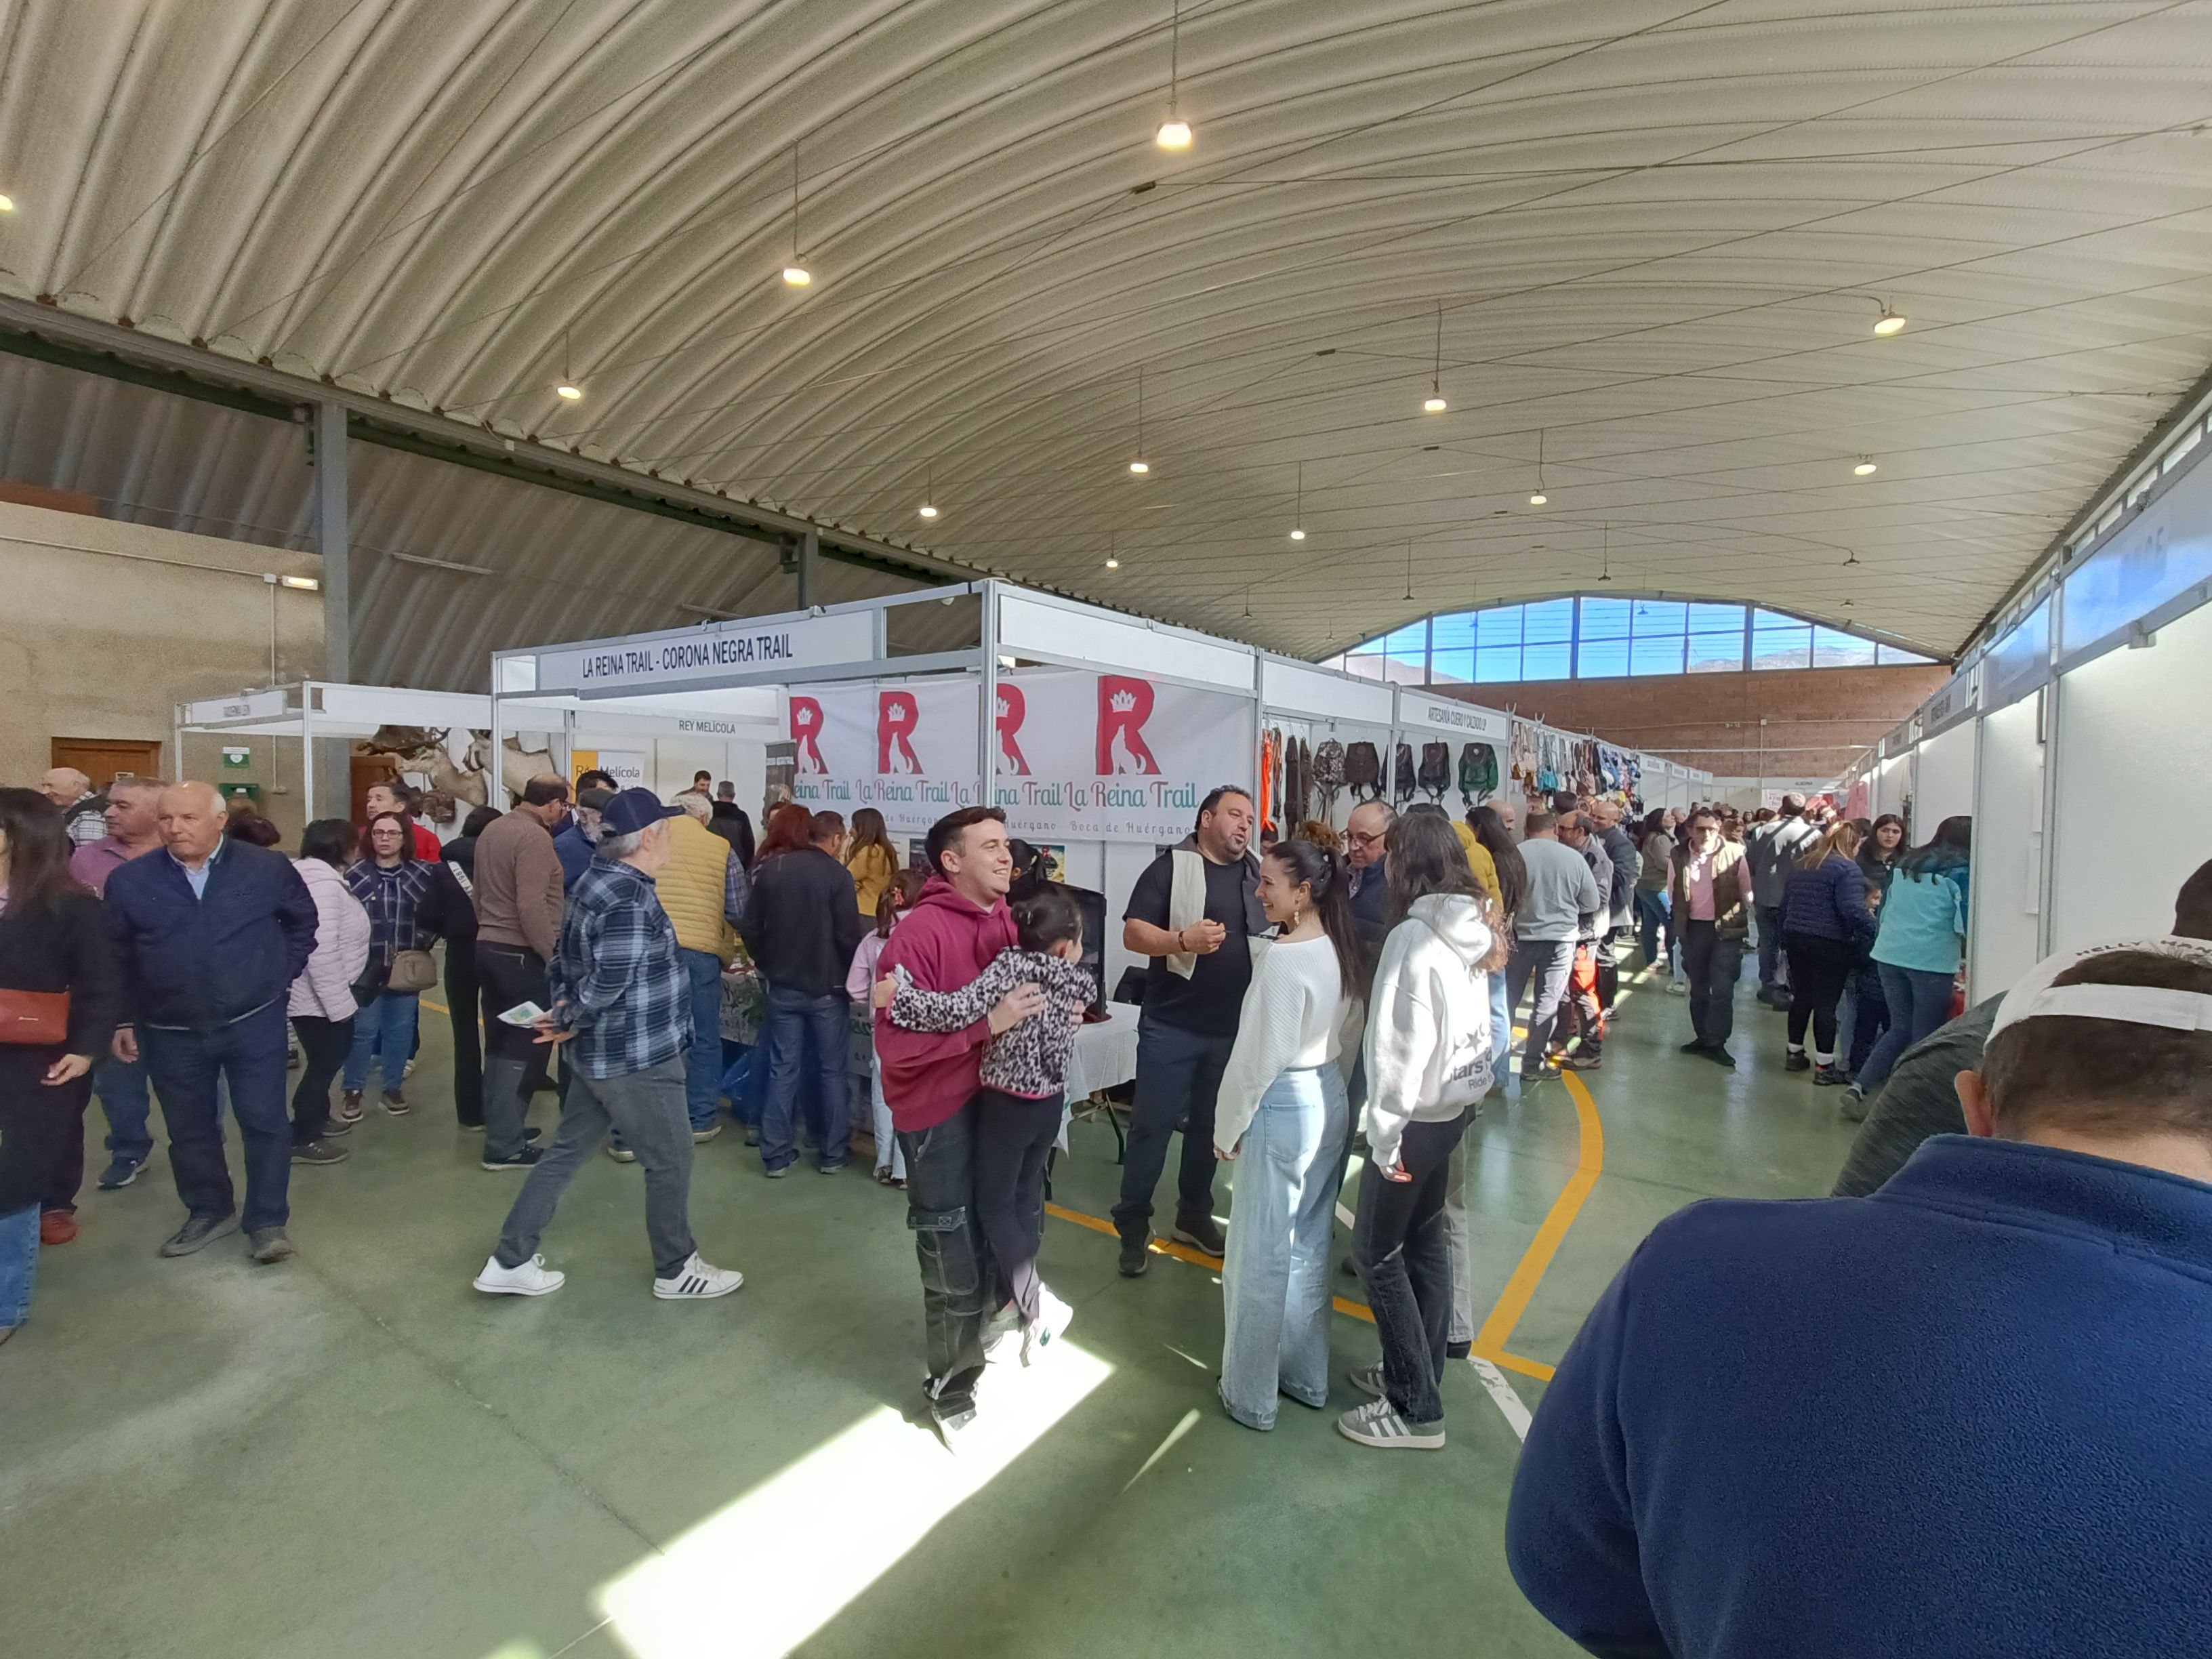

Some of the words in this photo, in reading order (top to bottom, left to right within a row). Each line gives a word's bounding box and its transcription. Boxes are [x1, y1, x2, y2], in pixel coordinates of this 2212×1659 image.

[582, 658, 594, 678] LA
[596, 654, 624, 676] REINA
[626, 651, 654, 673] TRAIL
[662, 644, 710, 670] CORONA
[712, 638, 754, 665] NEGRA
[756, 634, 794, 660] TRAIL
[679, 720, 695, 732] REY
[696, 720, 736, 734] MELÍCOLA
[794, 779, 821, 799] eina
[822, 779, 851, 800] Trail
[855, 779, 873, 804] La
[874, 779, 914, 802] Reina
[916, 780, 949, 803] Trail
[950, 781, 971, 808] La
[1021, 781, 1063, 806] Trail
[1064, 781, 1089, 812] La
[1090, 781, 1148, 808] Reina
[1149, 781, 1200, 808] Trail
[899, 814, 939, 826] Huérgan
[1070, 820, 1099, 832] Boca
[1106, 822, 1119, 832] de
[1126, 821, 1193, 837] Huérgano
[1448, 1060, 1483, 1084] tars
